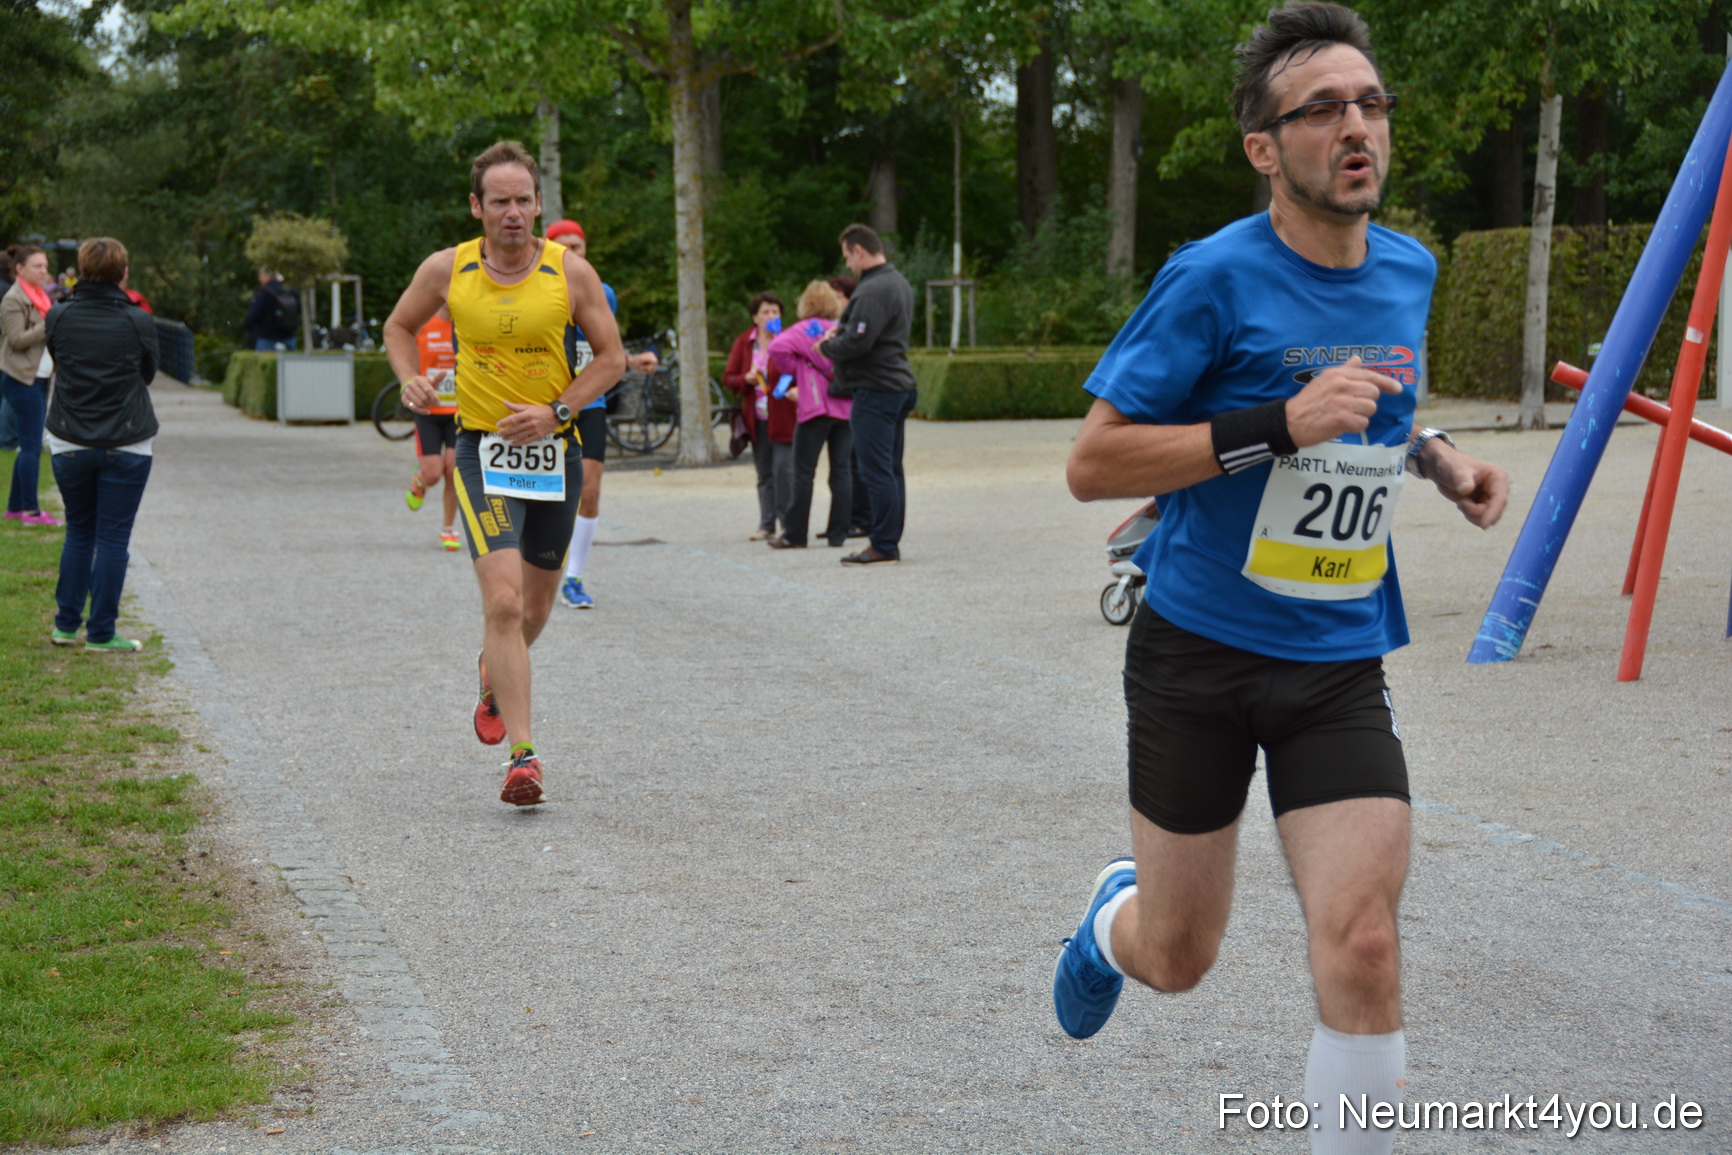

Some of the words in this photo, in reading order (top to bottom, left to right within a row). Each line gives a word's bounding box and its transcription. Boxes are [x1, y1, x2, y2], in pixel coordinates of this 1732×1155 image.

[1283, 345, 1394, 366] SYNERGY
[489, 442, 557, 472] 2559
[1278, 455, 1332, 474] PARTL
[1335, 460, 1396, 477] Neumarkt
[1293, 482, 1388, 541] 206
[1311, 556, 1352, 579] Karl
